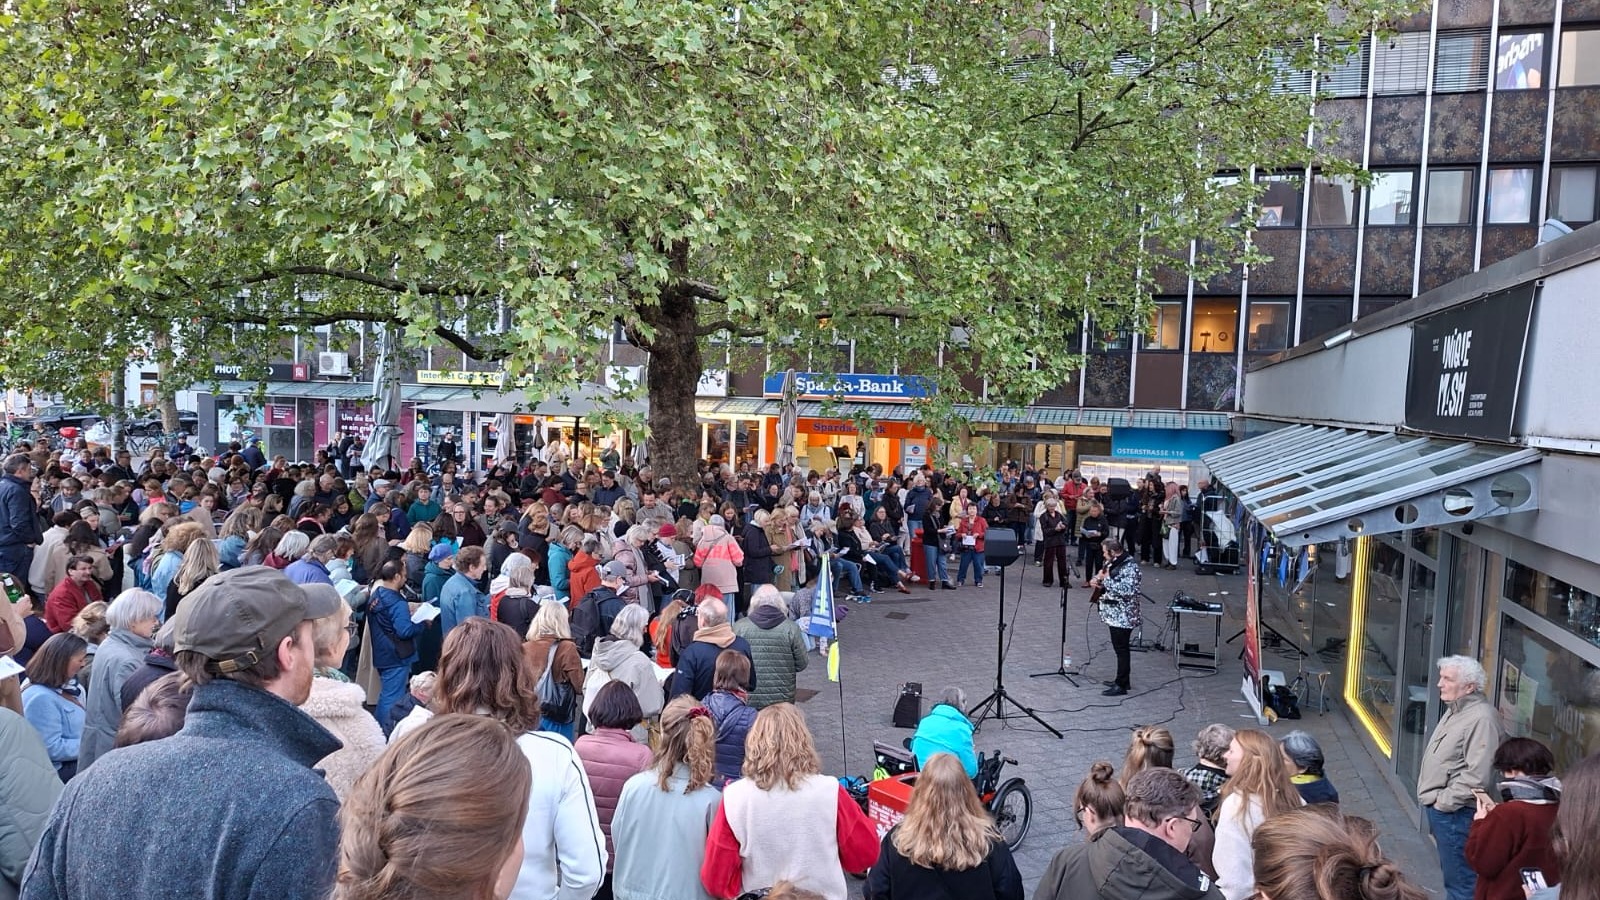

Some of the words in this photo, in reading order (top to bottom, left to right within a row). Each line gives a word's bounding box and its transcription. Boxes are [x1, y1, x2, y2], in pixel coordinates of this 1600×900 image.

[420, 371, 455, 380] Interet
[796, 377, 904, 394] Spada-Bank
[1116, 448, 1169, 456] OSTERSTRASSE
